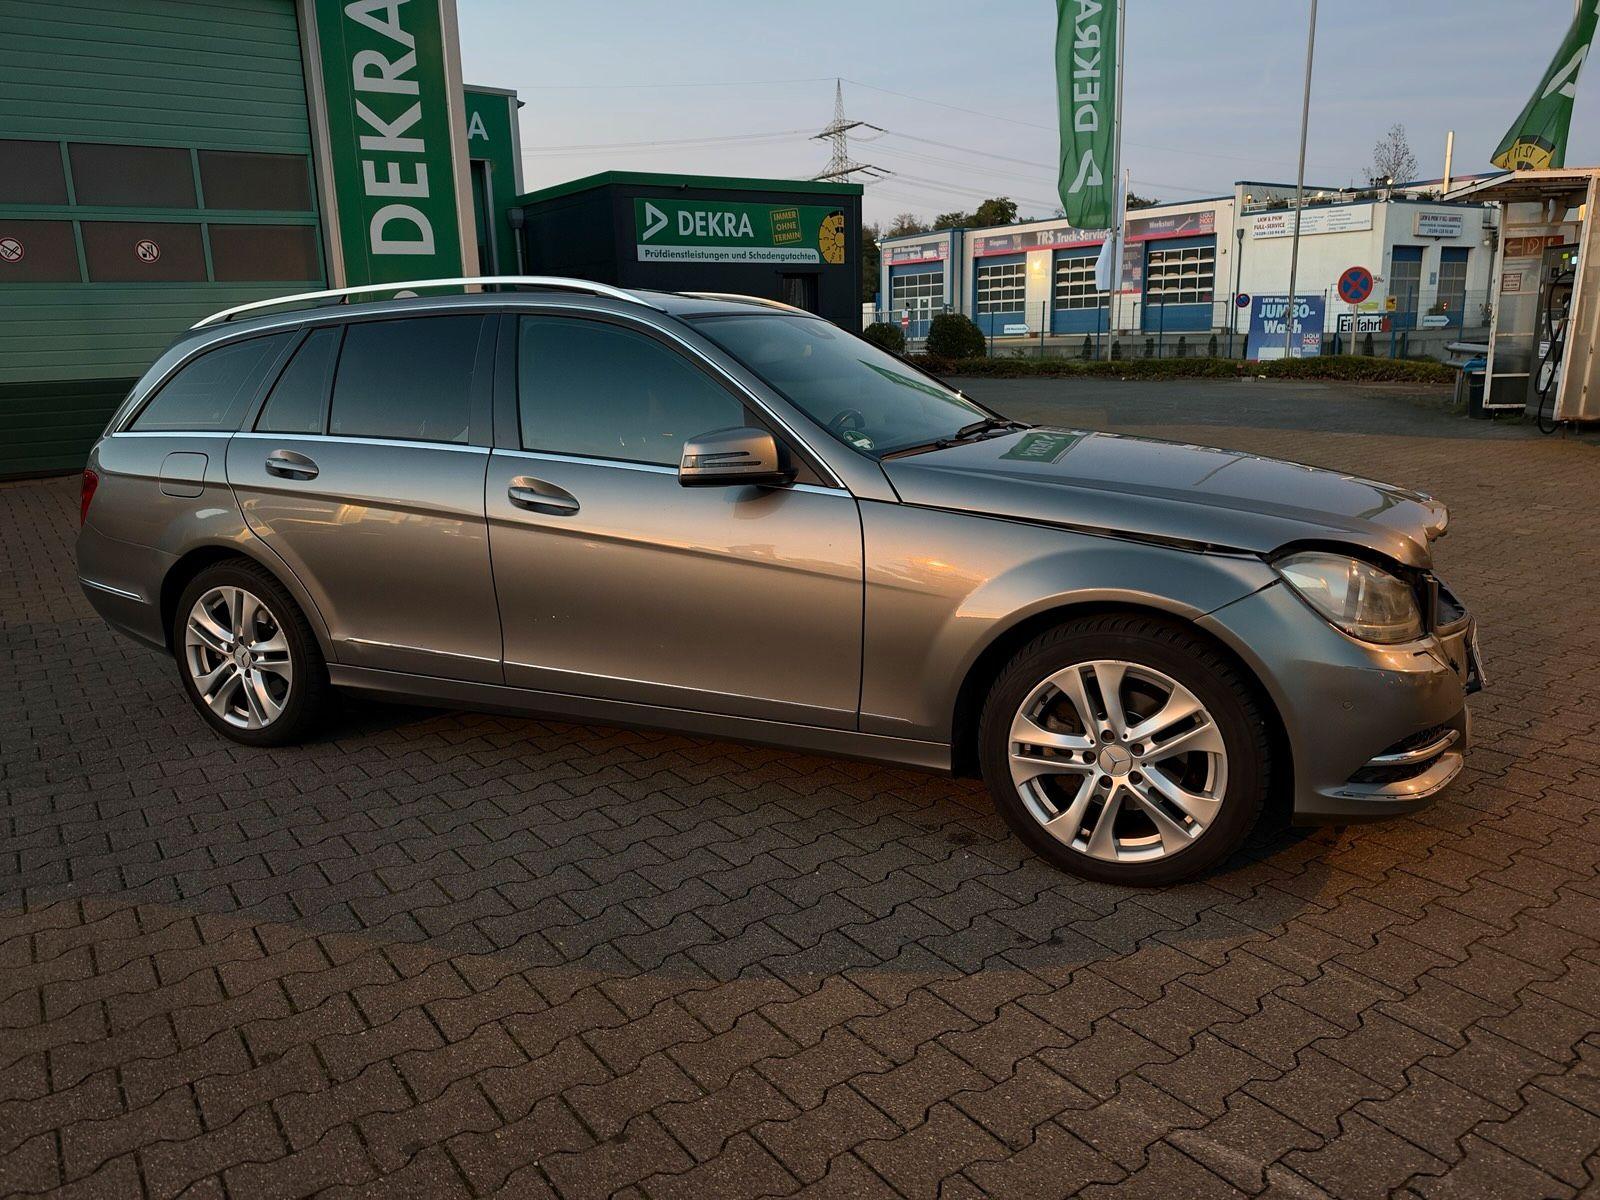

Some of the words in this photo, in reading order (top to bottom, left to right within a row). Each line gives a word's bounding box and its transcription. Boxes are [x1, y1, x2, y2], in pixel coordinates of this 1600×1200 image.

[344, 0, 435, 256] DEKRA
[773, 209, 797, 220] IMMER
[678, 210, 755, 238] DEKRA
[776, 221, 797, 232] OHNE
[774, 231, 802, 243] TERMIN
[1036, 230, 1055, 245] TRS
[644, 249, 730, 261] Prüfdienstleistungen
[731, 251, 747, 260] und
[748, 251, 817, 262] Schadengutachten
[1263, 318, 1302, 334] Wah
